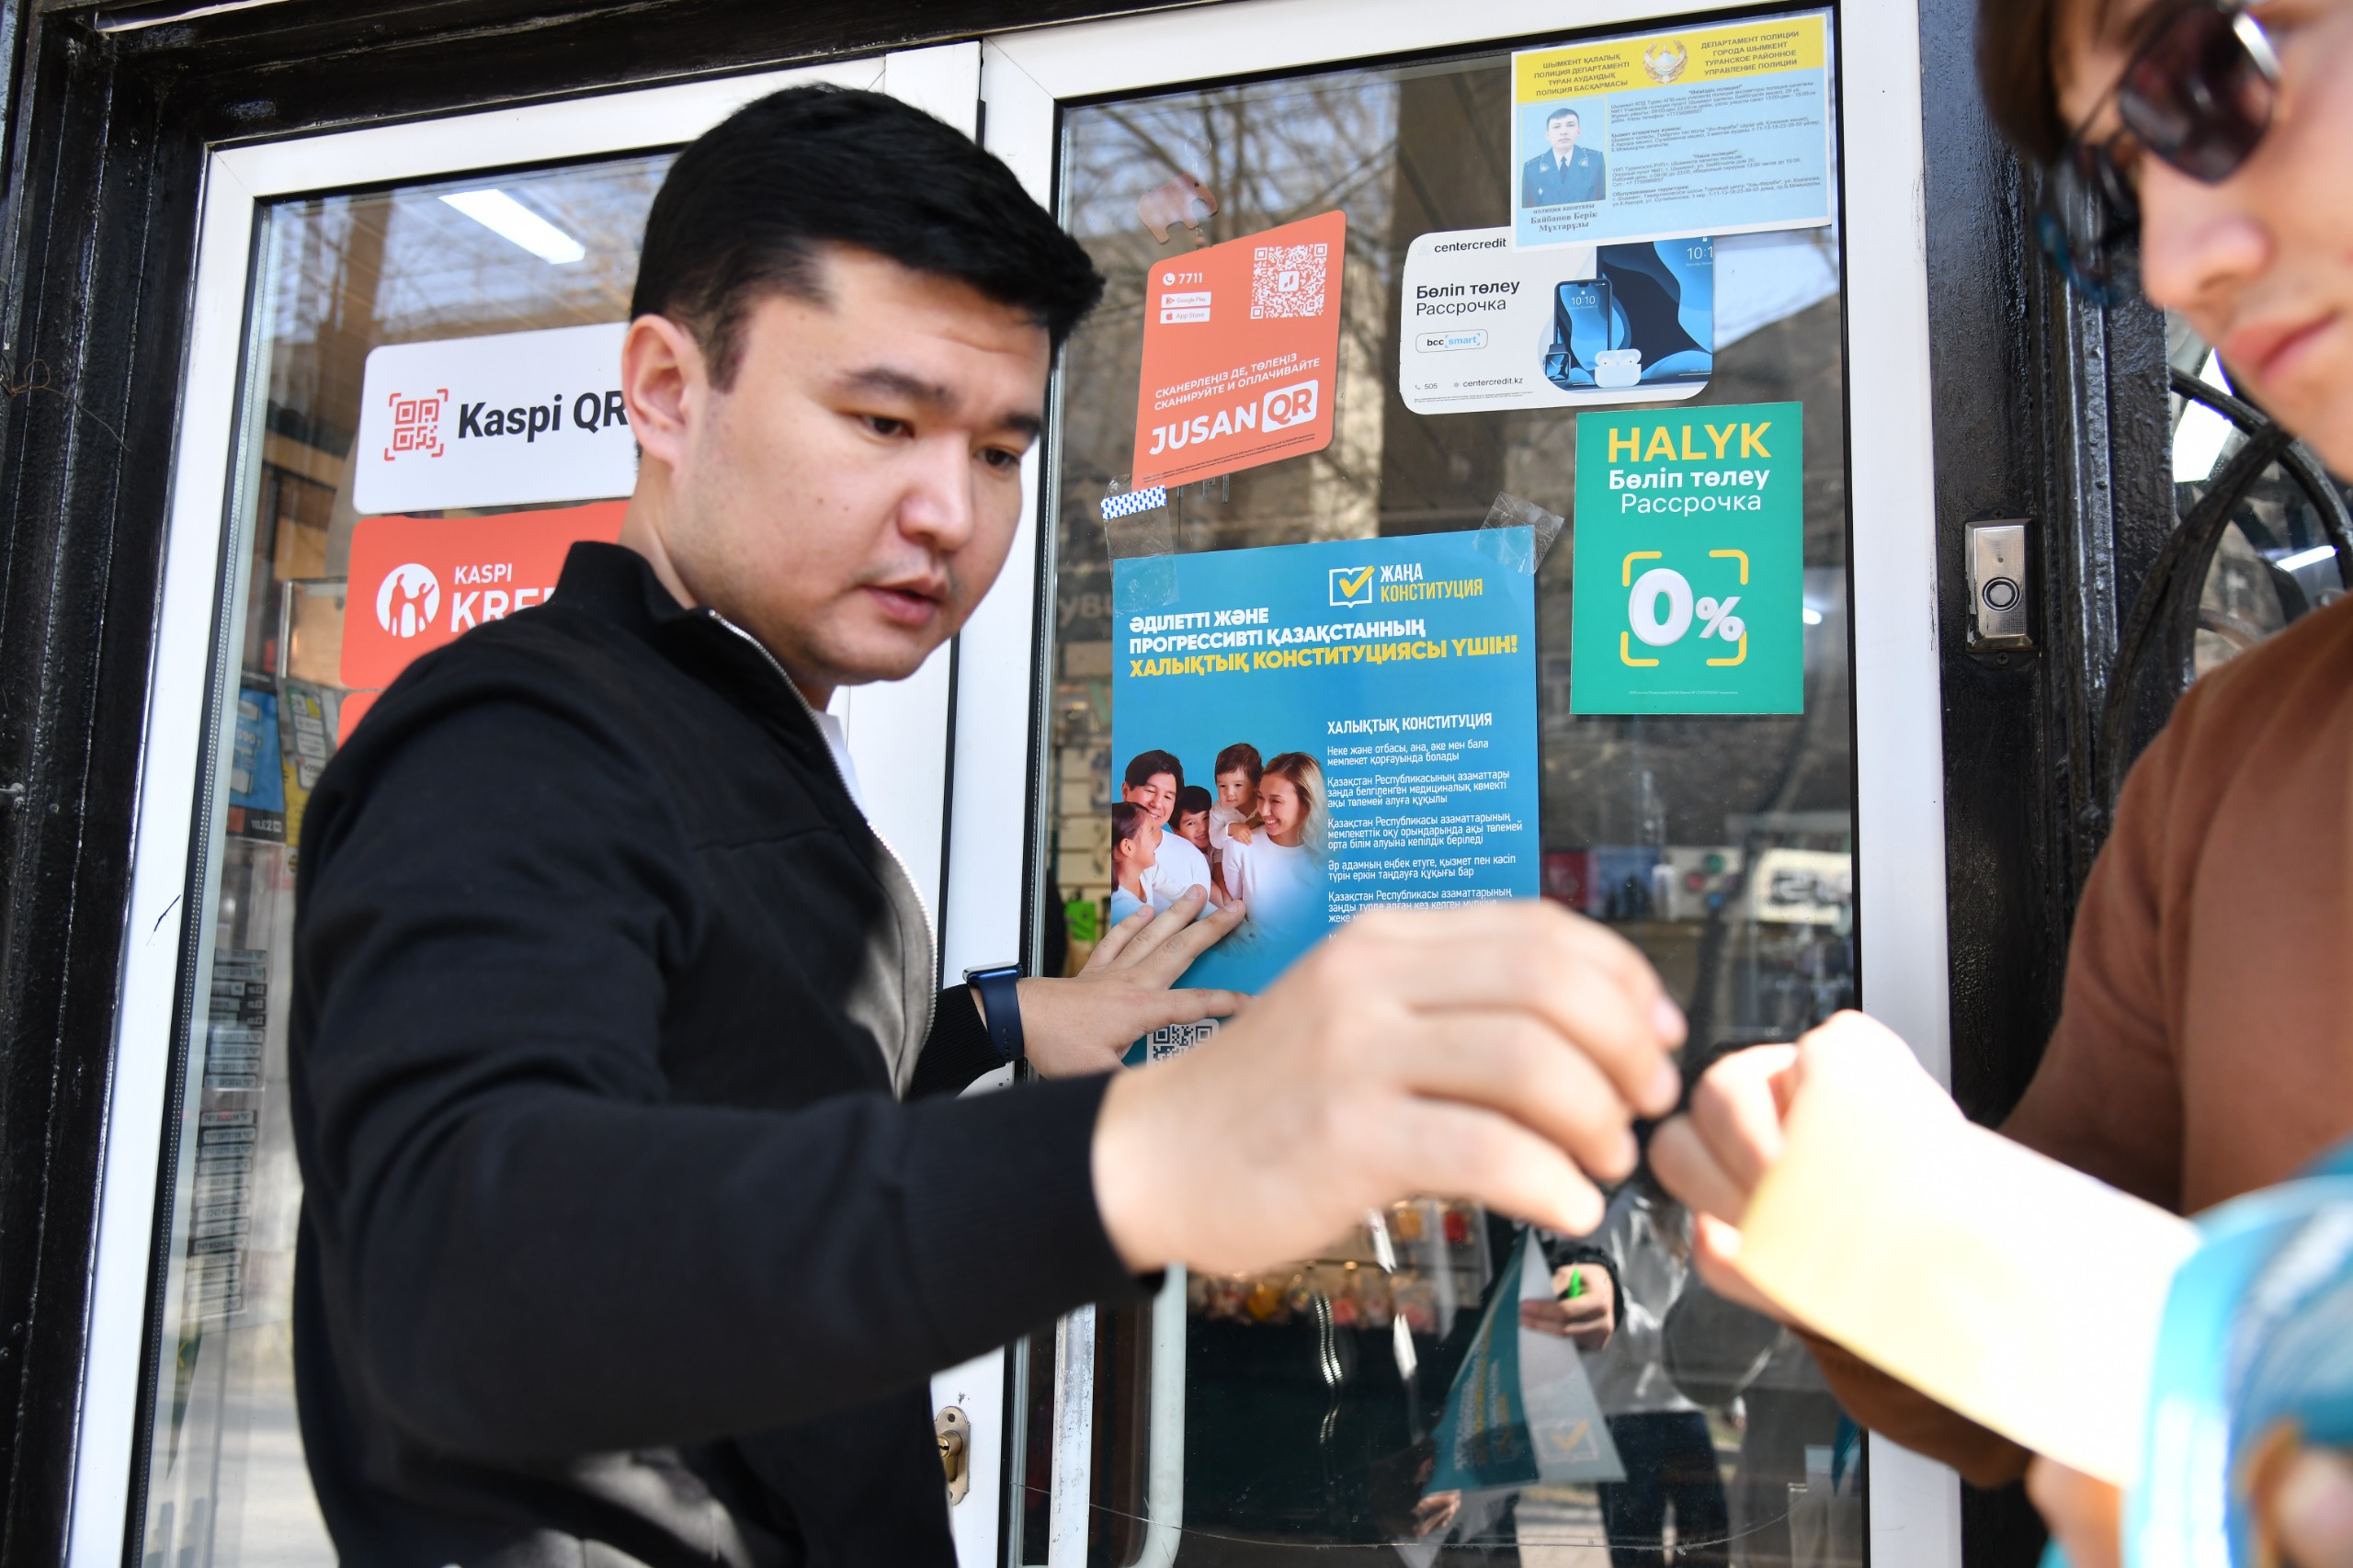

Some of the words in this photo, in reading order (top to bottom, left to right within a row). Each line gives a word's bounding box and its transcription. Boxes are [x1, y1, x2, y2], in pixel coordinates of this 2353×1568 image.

[1701, 36, 1757, 49] ДЕПАРТАМЕНТ
[1760, 30, 1799, 41] ПОЛИЦИИ
[1713, 47, 1744, 56] ГОРОДА
[1746, 41, 1787, 51] ШЫМКЕНТ
[1542, 58, 1581, 68] ШЫМКЕНТ
[1584, 53, 1620, 63] ҚАЛАЛЫҚ
[1705, 55, 1750, 66] ТУРАНСКОЕ
[1752, 49, 1795, 60] РАЙОННОЕ
[1534, 69, 1569, 78] ПОЛИЦИЯ
[1572, 62, 1629, 74] ДЕПАРТАМЕНТІ
[1704, 63, 1756, 75] УПРАВЛЕНИЕ
[1758, 59, 1796, 69] ПОЛИЦИИ
[1536, 86, 1572, 96] ПОЛИЦИЯ
[1574, 80, 1627, 91] БАСҚАРМАСЫ
[1530, 213, 1571, 223] Байбанов
[1574, 210, 1597, 221] Берік
[1434, 237, 1506, 253] centercredit
[1178, 272, 1202, 284] 7711
[1416, 282, 1464, 299] Бөліп
[1470, 280, 1519, 297] төлеу
[1416, 296, 1506, 318] Рассрочка
[1571, 295, 1595, 305] 10:10
[1448, 335, 1476, 345] smart
[1154, 382, 1223, 411] СКАНИРУЙТЕ
[1227, 381, 1234, 391] И
[1237, 356, 1319, 388] ОПЛАЧИВАЙТЕ
[1155, 371, 1228, 399] СКАНЕРЛЕҢІЗ
[1231, 366, 1247, 379] ДЕ,
[1251, 352, 1296, 373] ТӨЛЕҢІЗ
[1463, 377, 1522, 387] centercredit.kz
[458, 394, 562, 443] Kaspi
[574, 391, 629, 434] QR
[1149, 403, 1256, 455] JUSAN
[1267, 388, 1313, 425] QR
[1608, 422, 1772, 463] HALYK
[1609, 467, 1683, 490] Бөліп
[1690, 469, 1770, 490] төлеу
[1621, 494, 1761, 517] Рассрочка
[454, 563, 512, 585] KASPI
[1380, 562, 1423, 584] ЖАҢА
[1381, 578, 1483, 603] КОНСТИТУЦИЯ
[450, 587, 555, 632] KRE
[1629, 568, 1745, 646] 0%
[1129, 611, 1209, 635] ӘДІЛЕТТІ
[1213, 607, 1268, 627] ЖӘНЕ
[1130, 630, 1262, 653] ПРОГРЕССИВТІ
[1267, 619, 1426, 646] ҚАЗАҚСТАННЫҢ
[1130, 653, 1248, 679] ХАЛЫҚТЫҚ
[1254, 640, 1447, 670] КОНСТИТУЦИЯСЫ
[1452, 635, 1518, 658] ҮШІН!
[1327, 718, 1399, 736] ХАЛЫҚТЫҚ
[1402, 712, 1493, 733] КОНСТИТУЦИЯ
[1327, 744, 1347, 756] Неке
[1350, 745, 1371, 755] және
[1375, 742, 1407, 754] отбасы,
[1410, 743, 1427, 753] ана,
[1430, 742, 1445, 750] әке
[1448, 741, 1464, 749] мен
[1467, 738, 1488, 748] бала
[1327, 756, 1367, 766] мемлекет
[1370, 754, 1422, 766] қорғауында
[1426, 750, 1459, 762] болады
[1327, 777, 1372, 788] Қазақстан
[1375, 775, 1455, 787] Республикасының
[1458, 770, 1509, 782] азаматтары
[1327, 789, 1353, 799] заңда
[1356, 784, 1406, 796] белгіленген
[1410, 783, 1471, 795] медициналық
[1473, 778, 1506, 790] көмекті
[1327, 799, 1345, 809] ақы
[1347, 795, 1382, 806] төлемей
[1385, 796, 1409, 807] алуға
[1413, 795, 1447, 806] құқылы
[1327, 819, 1372, 829] Қазақстан
[1375, 816, 1437, 829] Республикасы
[1440, 812, 1510, 825] азаматтарының
[1327, 826, 1380, 839] мемлекеттік
[1382, 828, 1398, 839] оқу
[1401, 824, 1462, 838] орындарында
[1465, 824, 1483, 834] ақы
[1486, 820, 1522, 832] төлемей
[1328, 841, 1347, 851] орта
[1349, 837, 1370, 848] білім
[1373, 838, 1404, 849] алуына
[1408, 836, 1444, 846] кепілдік
[1447, 833, 1483, 846] беріледі
[1328, 859, 1339, 871] Әр
[1342, 859, 1381, 870] адамның
[1384, 857, 1409, 869] еңбек
[1412, 858, 1436, 869] етуге,
[1439, 857, 1471, 868] қызмет
[1474, 857, 1490, 865] пен
[1493, 853, 1515, 864] кәсіп
[1328, 870, 1349, 882] түрін
[1353, 869, 1375, 881] еркін
[1378, 869, 1417, 881] таңдауға
[1421, 869, 1456, 880] құқығы
[1458, 865, 1473, 879] бар
[1328, 892, 1373, 903] Қазақстан
[1376, 890, 1438, 903] Республикасы
[1441, 887, 1511, 900] азаматтарының
[1328, 903, 1356, 914] заңды
[1328, 914, 1350, 923] жеке
